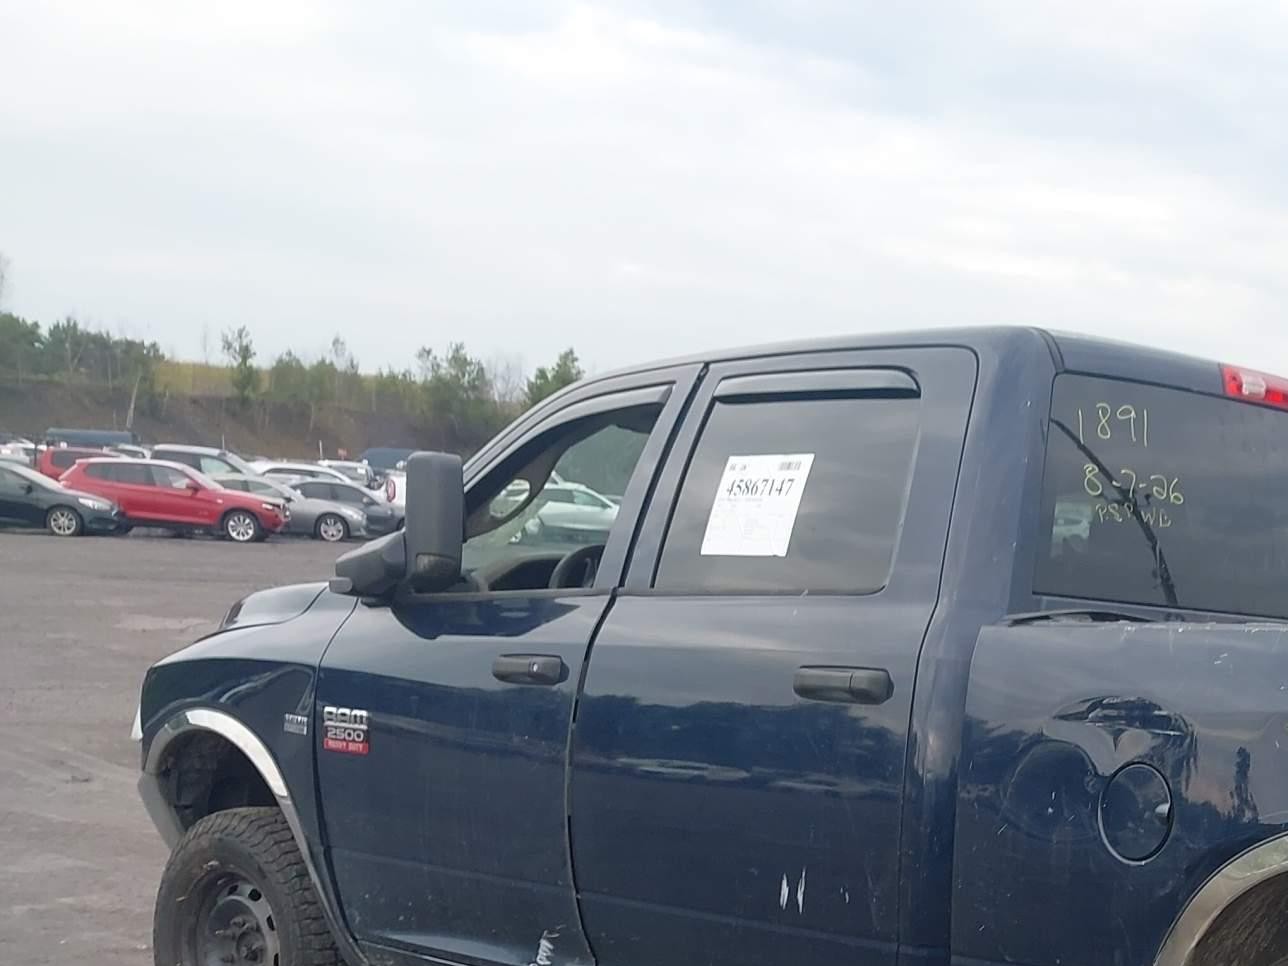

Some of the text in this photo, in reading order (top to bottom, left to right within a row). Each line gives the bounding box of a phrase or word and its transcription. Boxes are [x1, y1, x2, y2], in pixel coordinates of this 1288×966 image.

[1077, 402, 1149, 448] 1891
[726, 478, 796, 497] 45867147
[327, 726, 364, 742] 2500
